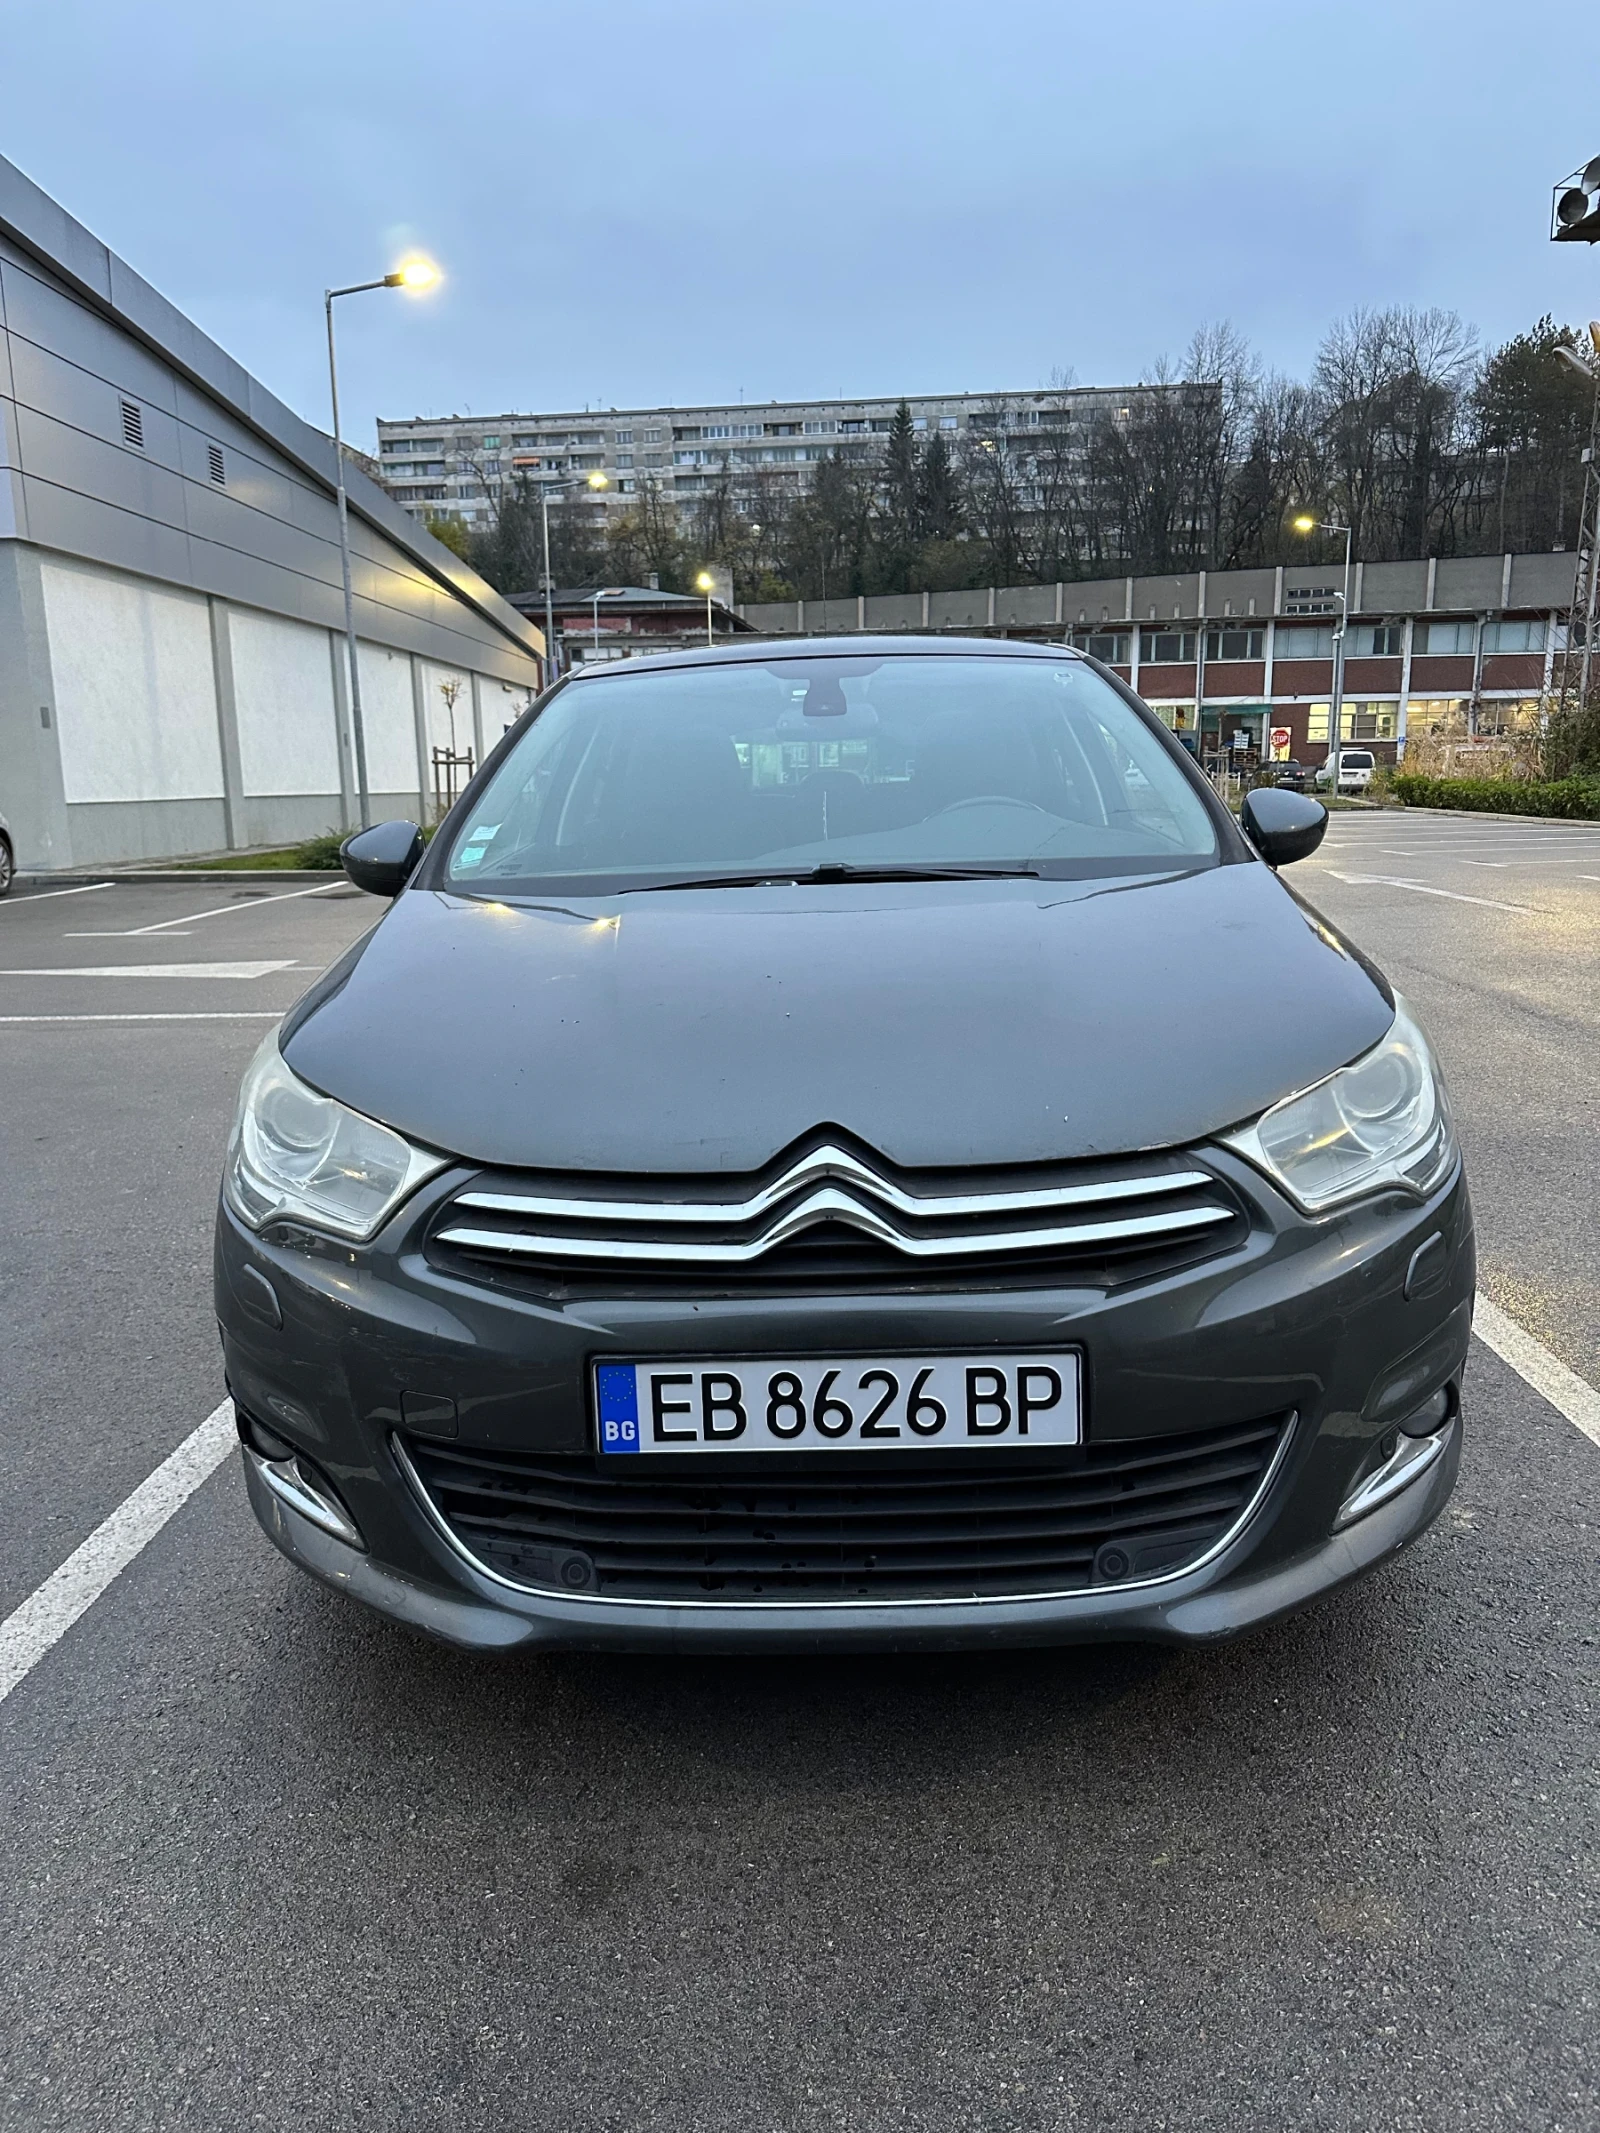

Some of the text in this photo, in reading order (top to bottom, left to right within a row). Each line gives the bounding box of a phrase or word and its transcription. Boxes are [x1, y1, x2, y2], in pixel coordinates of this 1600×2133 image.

[1272, 735, 1288, 743] STOP
[650, 1365, 1062, 1442] EB 8626 BP
[605, 1420, 636, 1441] BG
